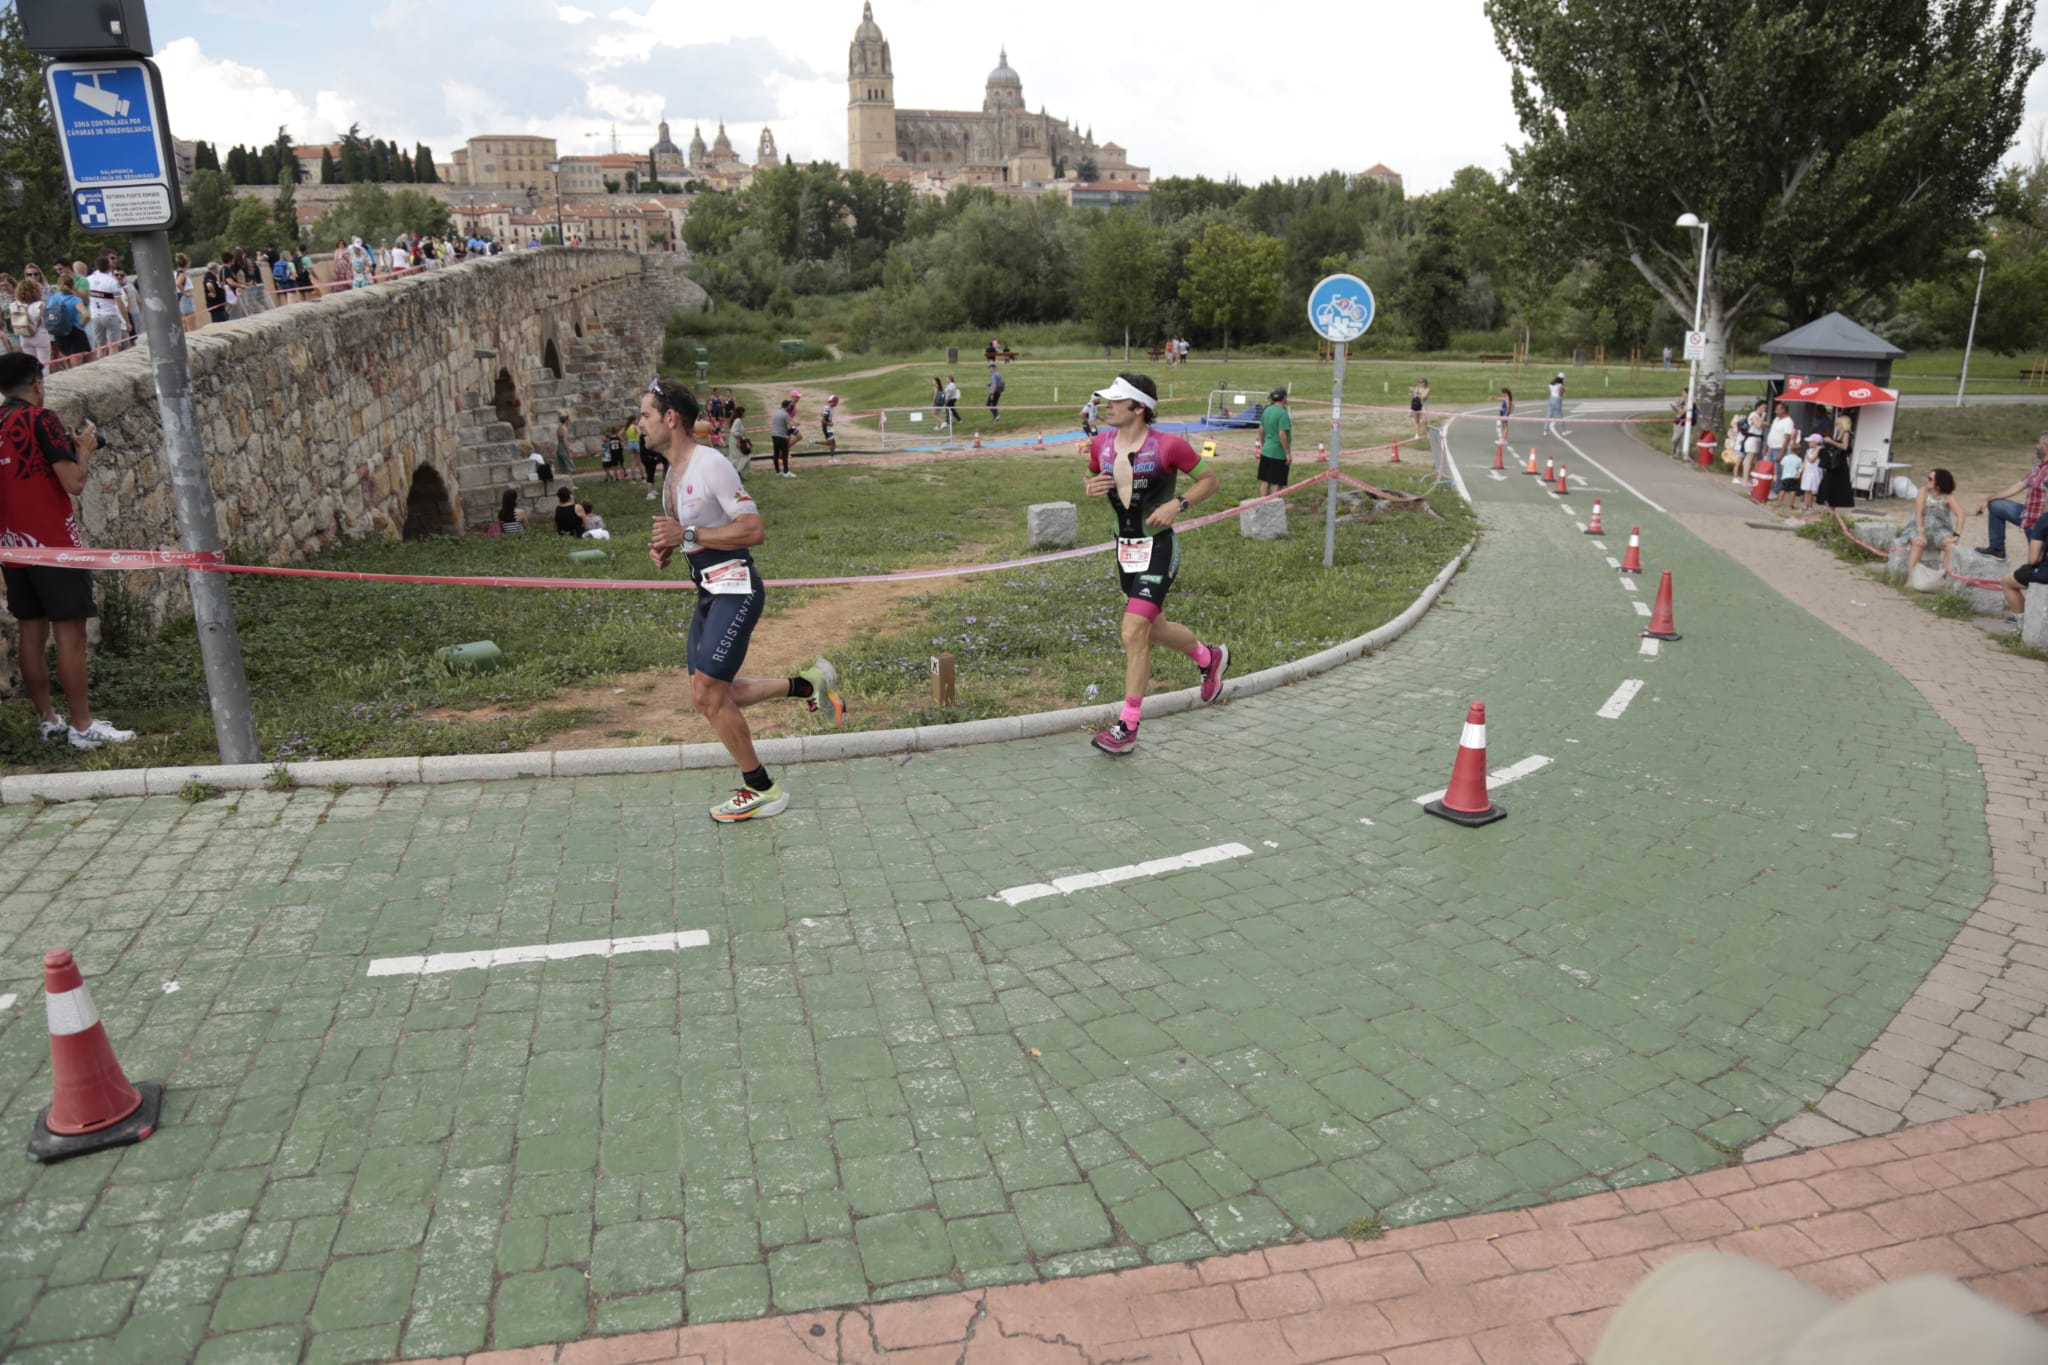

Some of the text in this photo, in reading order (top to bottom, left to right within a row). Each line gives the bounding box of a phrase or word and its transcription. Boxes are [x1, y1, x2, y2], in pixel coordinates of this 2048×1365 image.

[91, 118, 128, 127] CONTROLADA
[66, 128, 95, 136] CÁMARAS
[105, 126, 153, 134] VIDEOVIGILANCIA
